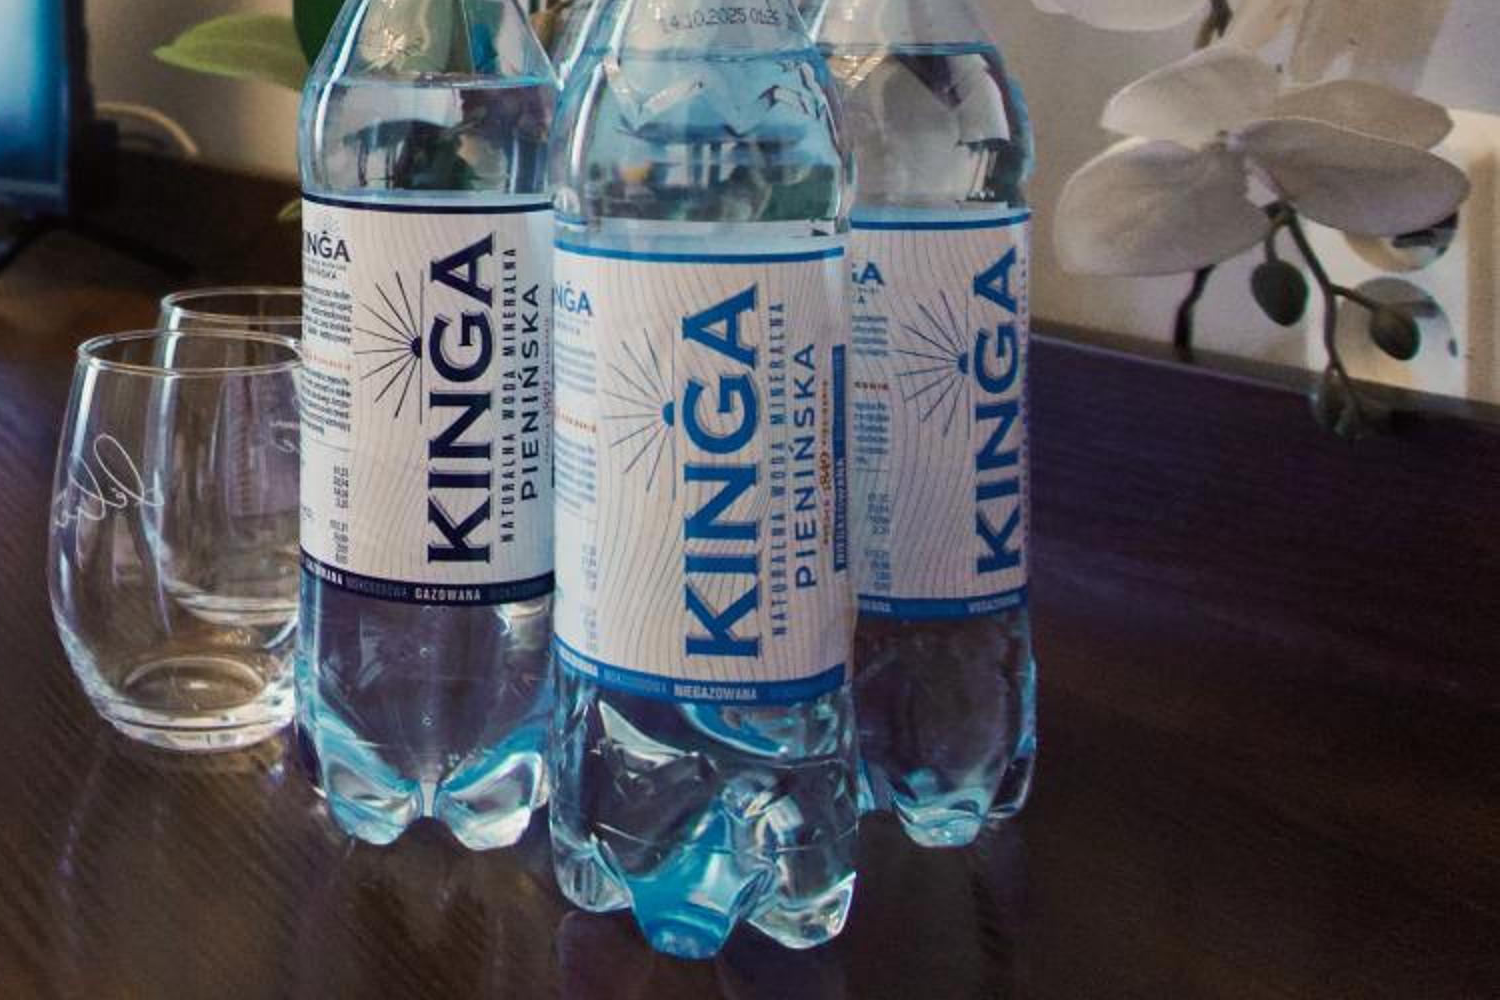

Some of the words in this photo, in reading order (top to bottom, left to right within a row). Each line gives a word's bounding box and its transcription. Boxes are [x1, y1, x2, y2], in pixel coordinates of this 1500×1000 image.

[306, 230, 351, 262] NGA
[501, 248, 517, 356] MINERALNA
[427, 232, 494, 564] KINGA
[501, 371, 517, 420] WODA
[517, 284, 539, 501] PIENIŃSKA
[768, 302, 786, 425] MINERALNA
[972, 246, 1021, 576] KINGA
[500, 432, 516, 543] NATURALNA
[681, 282, 762, 660] KINGA
[769, 440, 786, 498] WODA
[790, 343, 817, 590] PIENIŃSKA
[414, 586, 481, 601] GAZOWANA
[769, 512, 788, 637] NATURALNA
